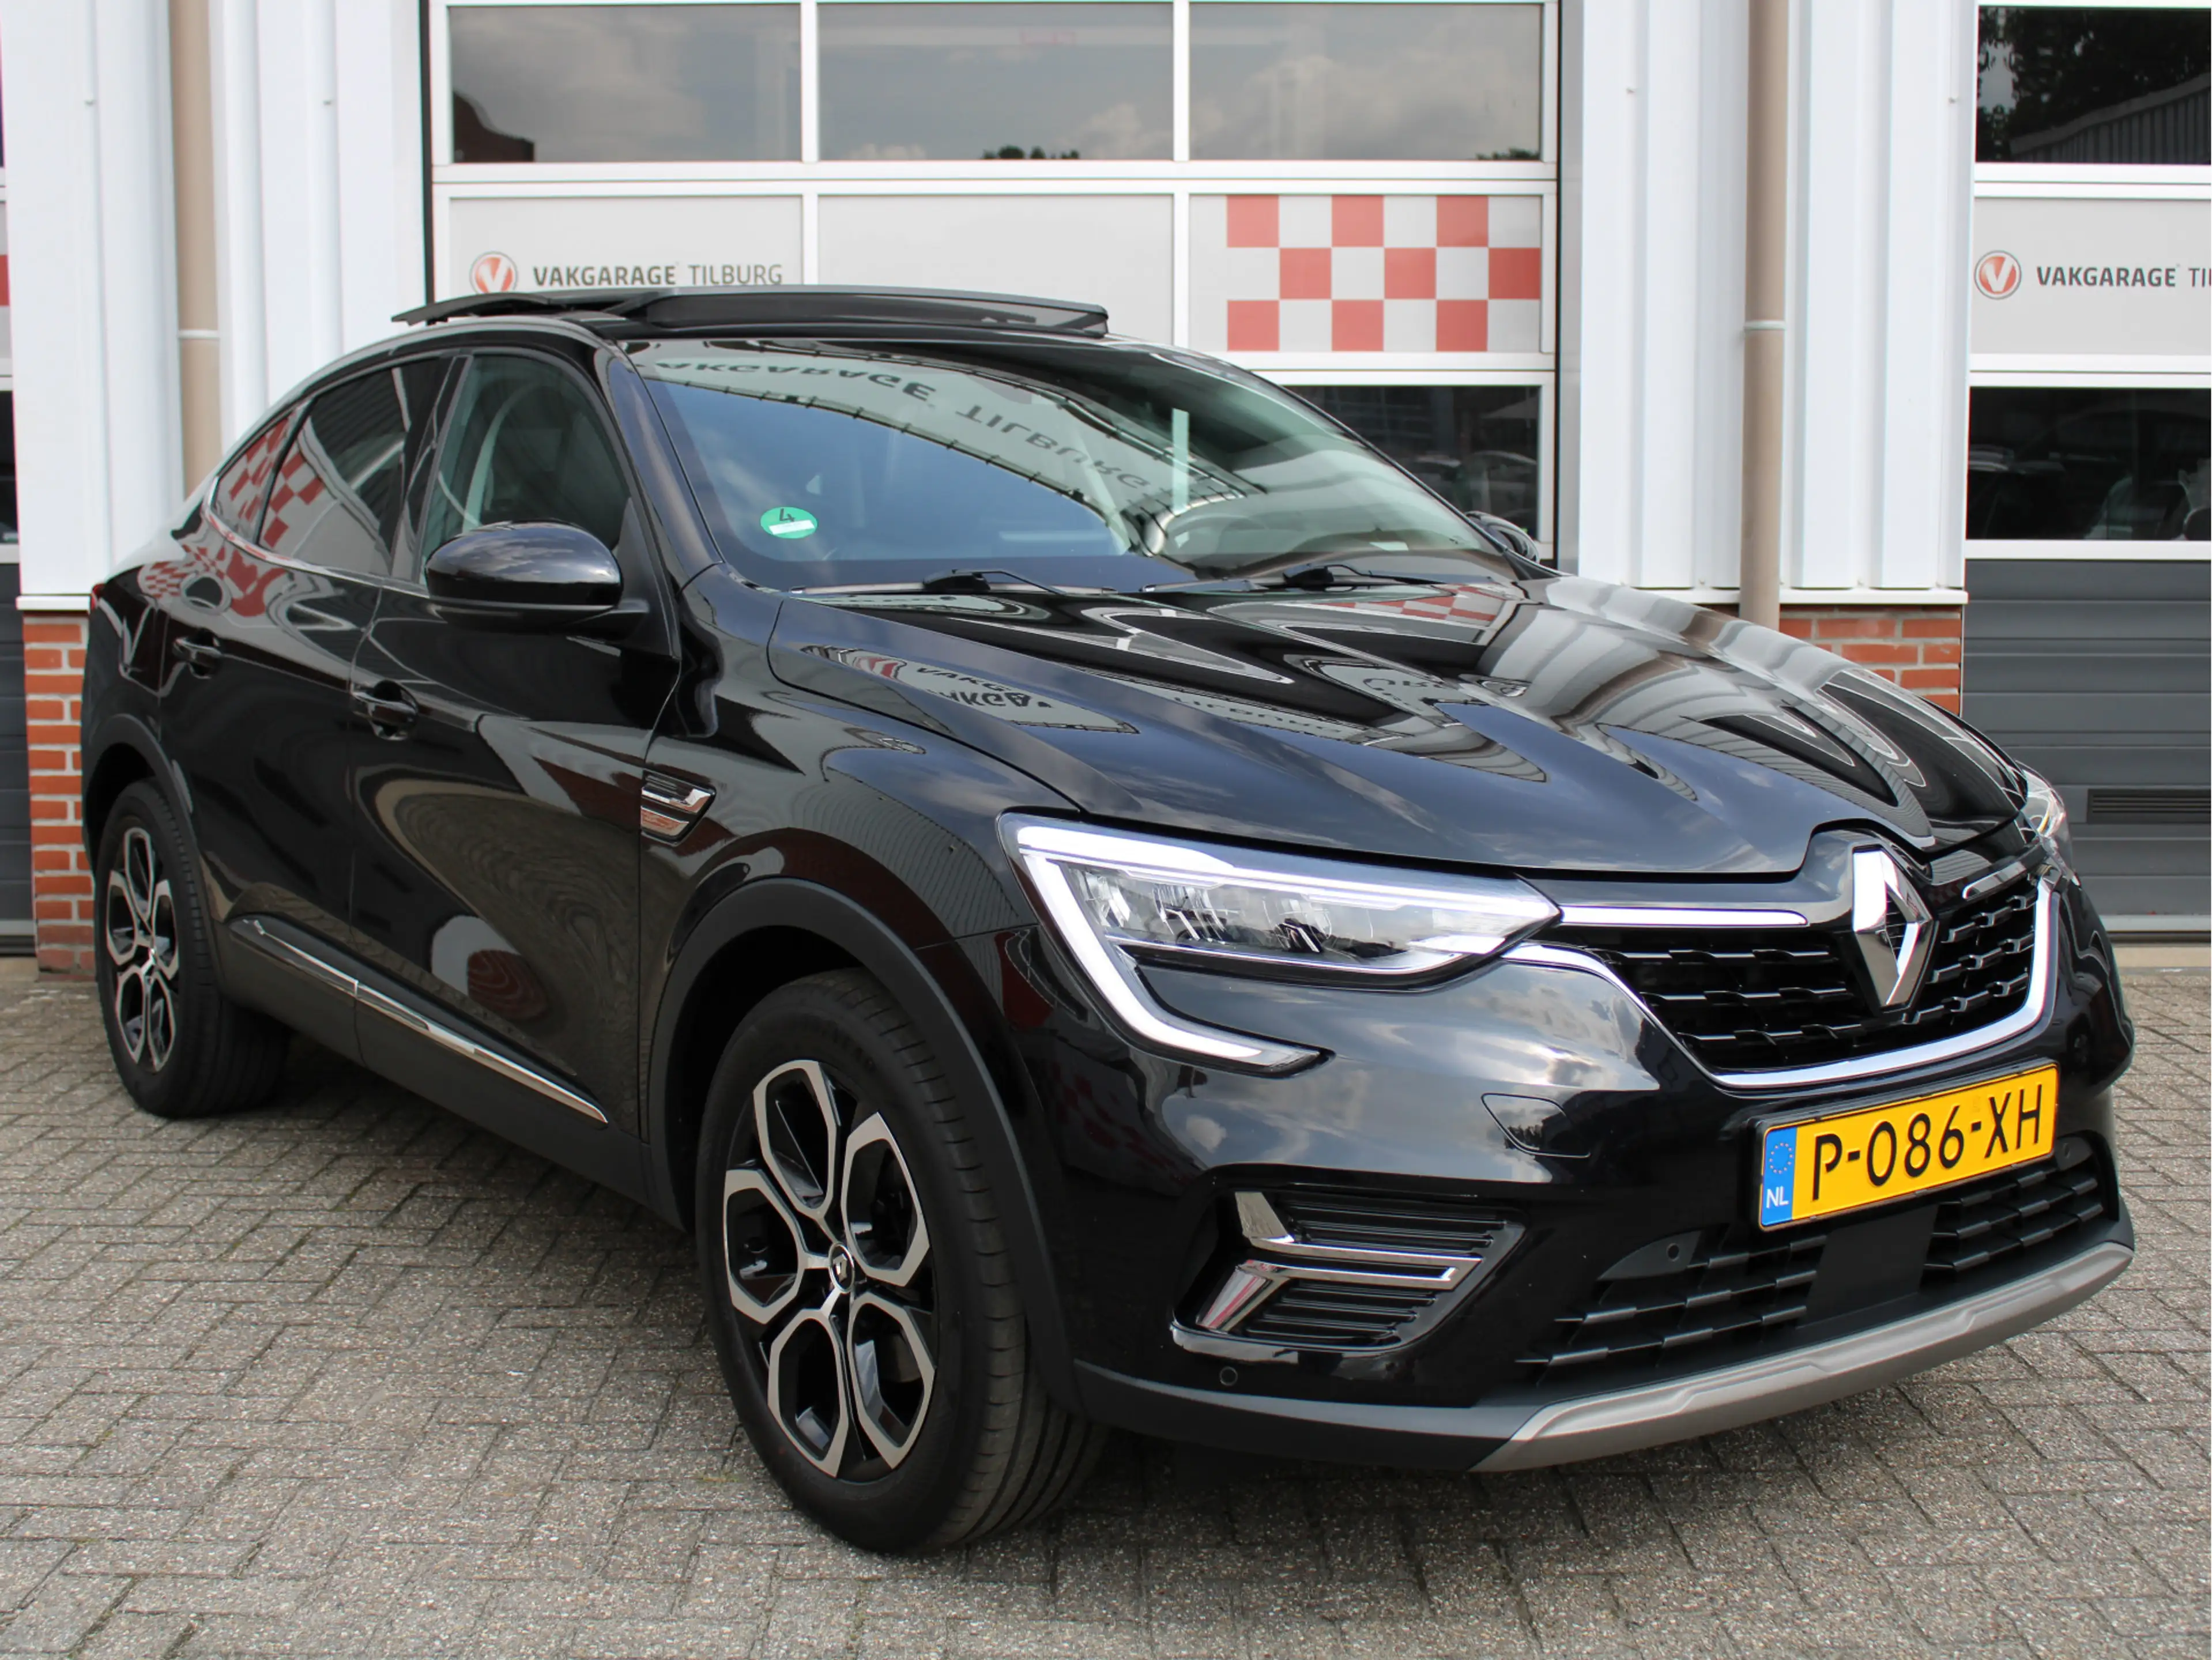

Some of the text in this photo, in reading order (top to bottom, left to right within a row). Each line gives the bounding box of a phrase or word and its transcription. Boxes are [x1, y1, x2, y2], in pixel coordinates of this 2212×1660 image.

[533, 265, 783, 286] VAKGARAGE TILBURG
[2037, 266, 2176, 287] VAKGARAGE
[779, 507, 796, 522] 4
[1811, 1084, 2043, 1201] P-086-XH
[1766, 1185, 1790, 1209] NL
